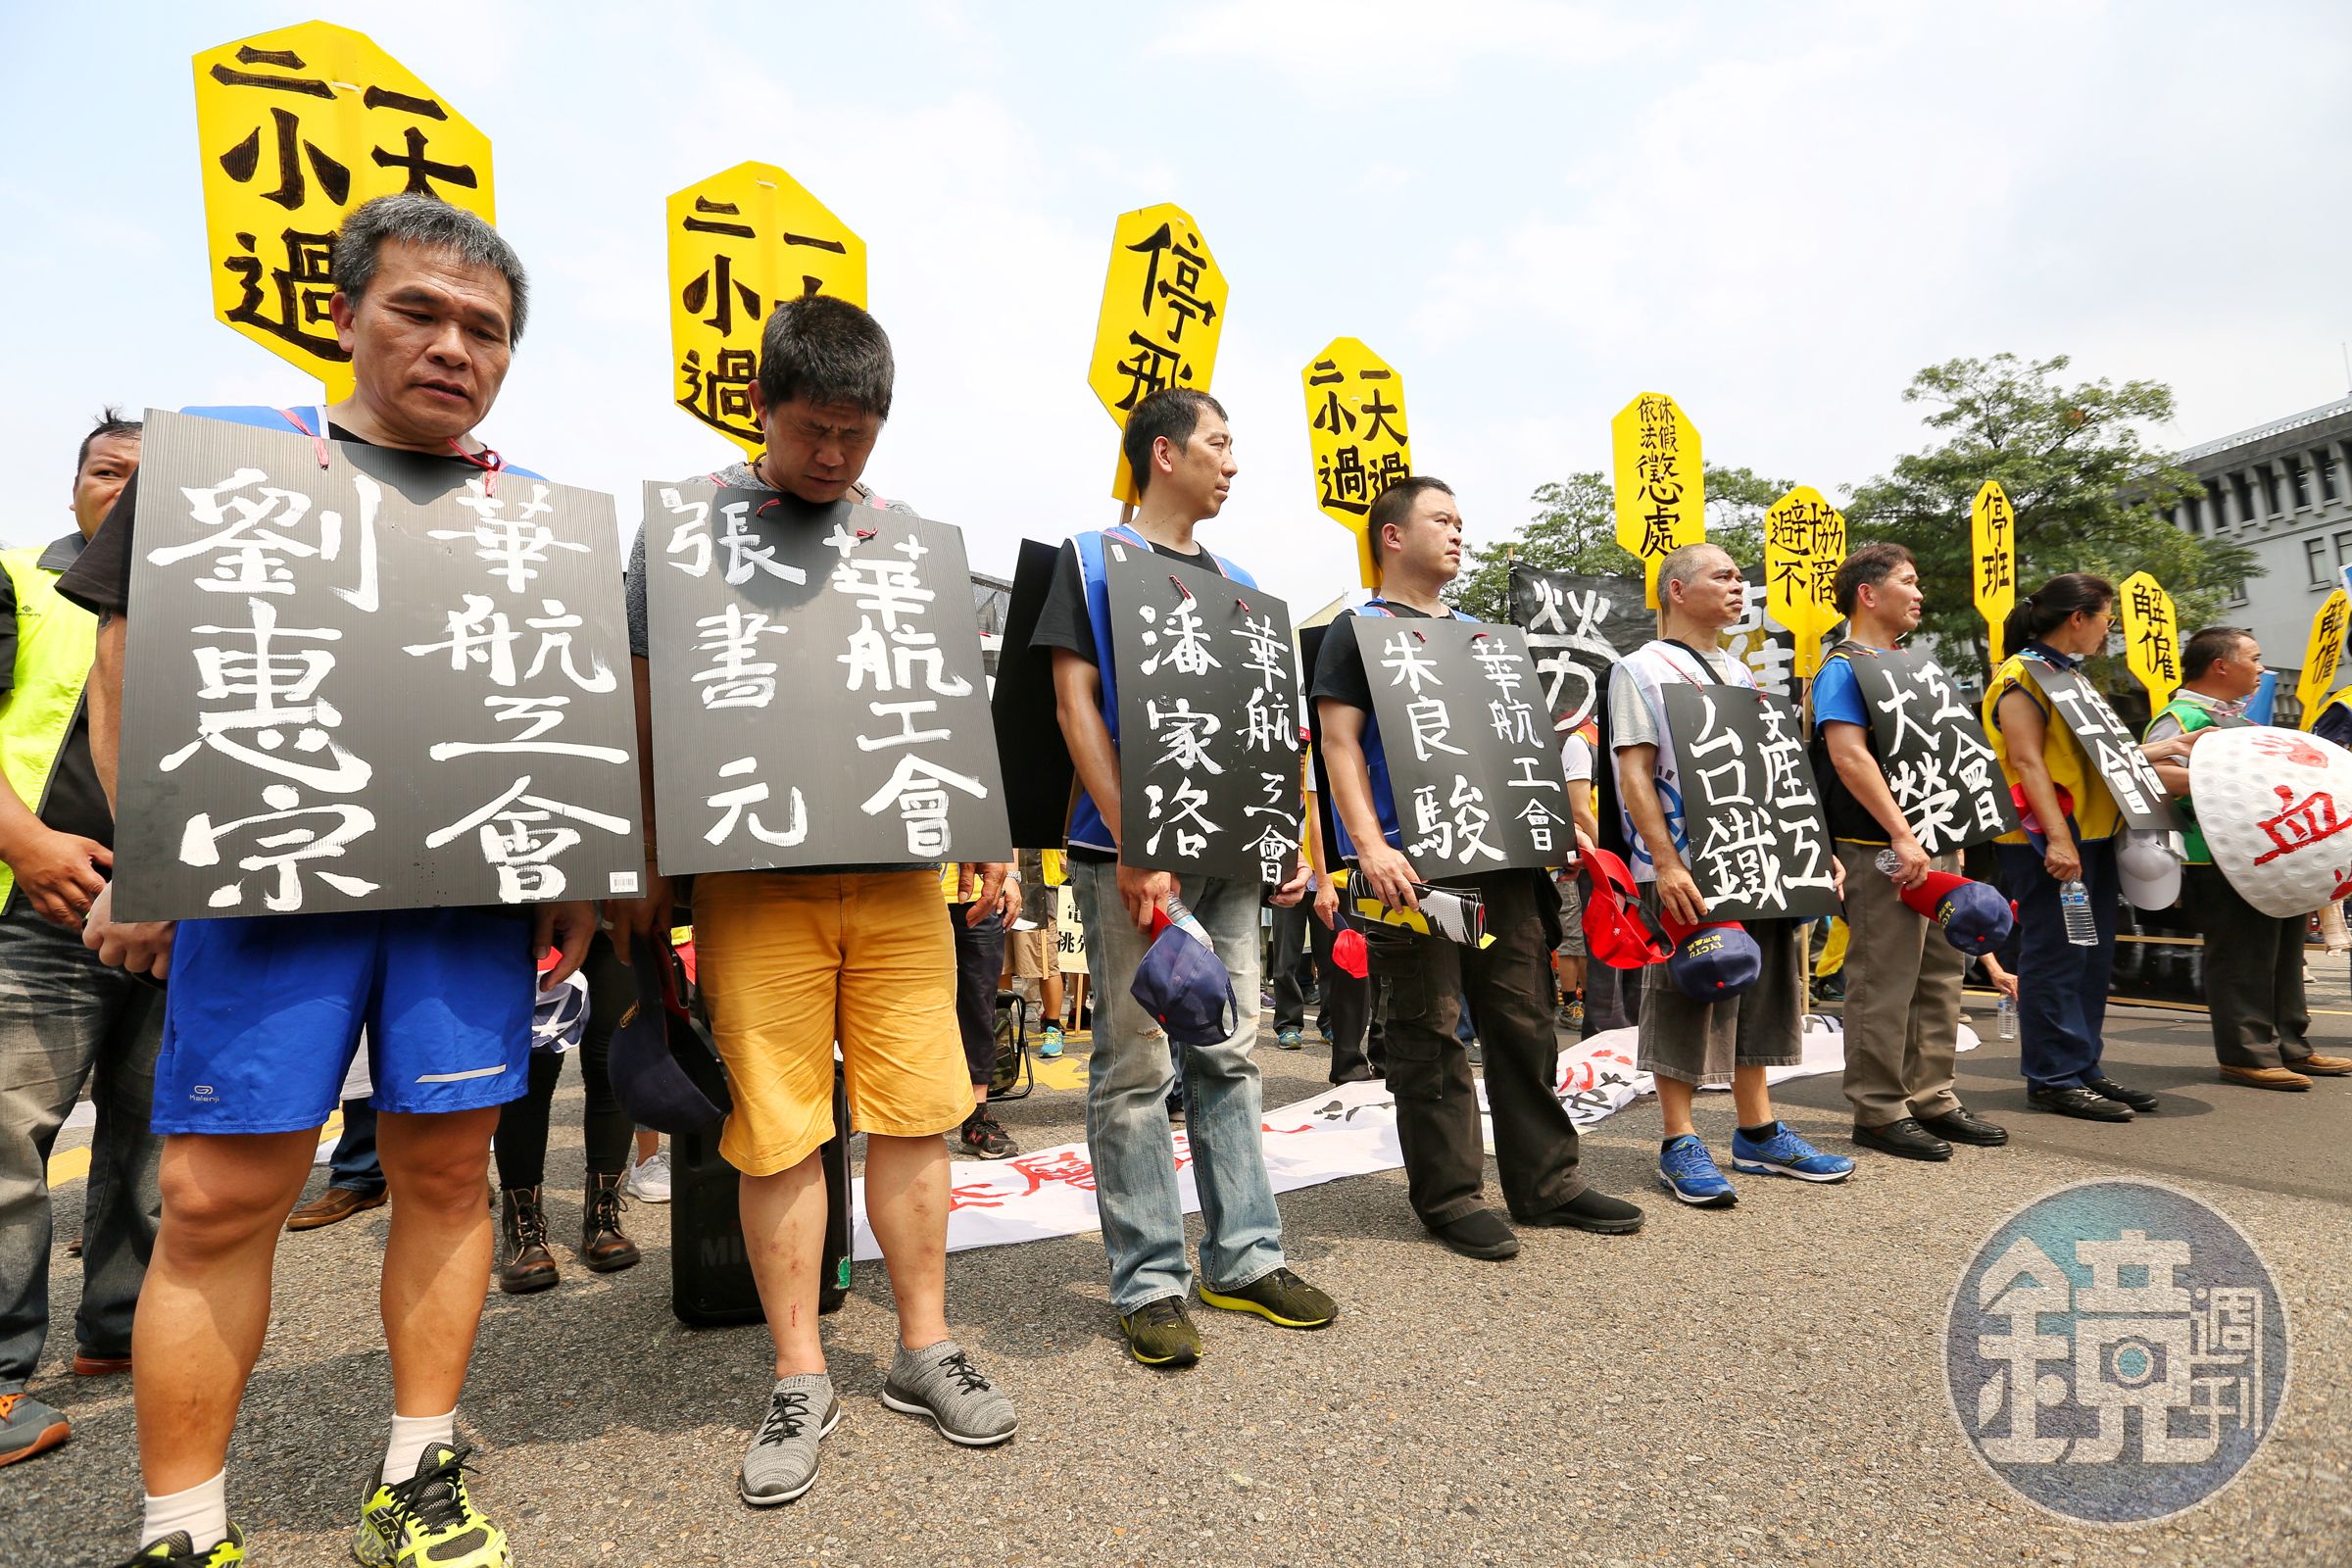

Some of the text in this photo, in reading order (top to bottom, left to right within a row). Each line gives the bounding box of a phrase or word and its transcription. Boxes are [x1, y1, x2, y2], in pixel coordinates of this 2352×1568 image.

[210, 44, 353, 363] 二小過
[676, 195, 765, 445] 二小過
[1636, 395, 1657, 450] 依法
[1657, 395, 1680, 453] 休假
[1309, 359, 1370, 515] 二小過
[1635, 450, 1684, 559] 懲處
[1982, 489, 2009, 598] 停班
[147, 467, 380, 911] 劉惠宗
[402, 477, 631, 904] 華航工會
[666, 501, 808, 847] 張書元
[822, 522, 989, 858] 華航工會
[1139, 594, 1228, 859] 潘家洛
[1230, 613, 1299, 885] 華航工會
[1380, 631, 1508, 865] 朱良駿
[1472, 637, 1566, 852] 華航工會
[2050, 689, 2151, 814] 工會
[1689, 695, 1788, 911] 台鐵
[1757, 700, 1837, 891] 產工
